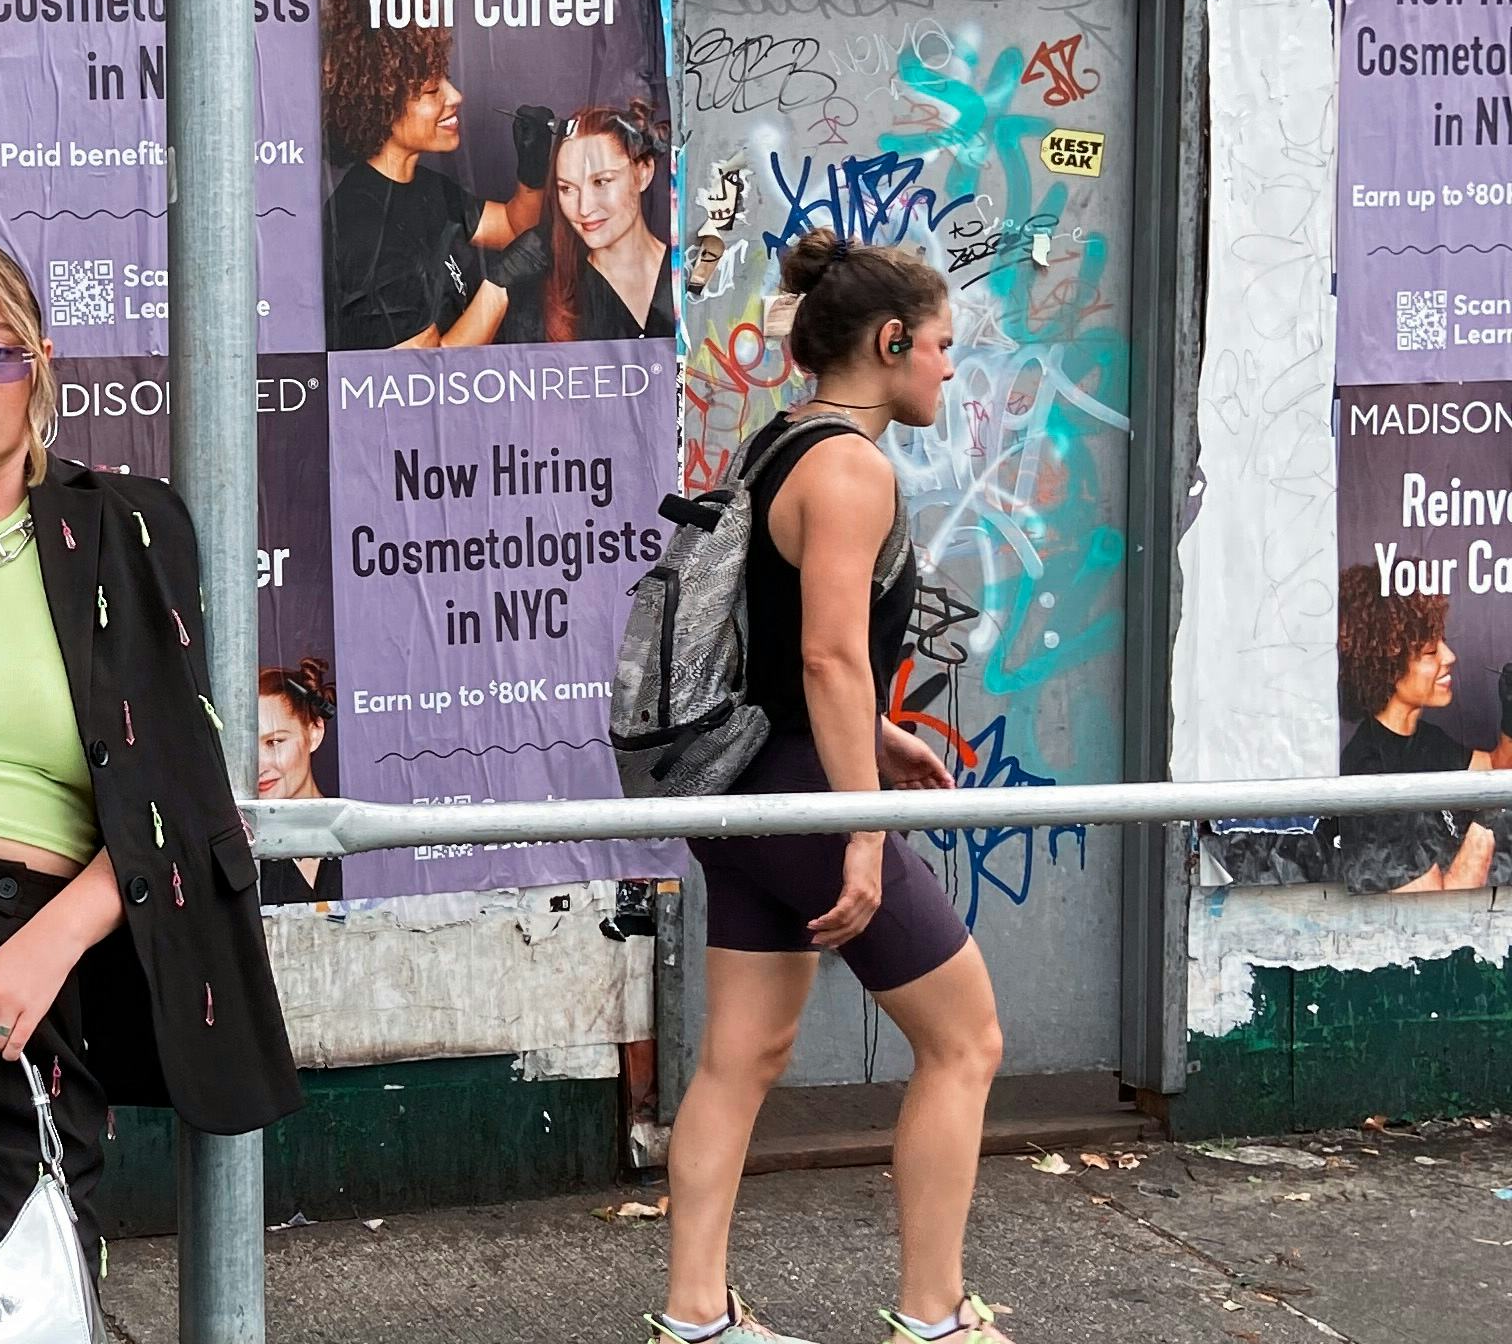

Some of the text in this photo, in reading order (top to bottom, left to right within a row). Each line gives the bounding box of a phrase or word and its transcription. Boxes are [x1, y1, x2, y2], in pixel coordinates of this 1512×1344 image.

[87, 50, 124, 100] in
[1434, 102, 1463, 146] in
[0, 142, 61, 167] Paid
[69, 141, 168, 167] benefit
[1049, 136, 1103, 156] KEST
[1050, 151, 1093, 170] GAK
[1352, 184, 1401, 207] Earn
[1407, 189, 1436, 212] up
[1441, 185, 1464, 206] to
[1453, 294, 1511, 316] Scan
[394, 444, 613, 508] Now Hiring
[351, 517, 662, 582] Cosmetologists
[1374, 542, 1458, 597] Your
[445, 587, 568, 646] in NYC
[353, 690, 412, 714] Earn
[419, 692, 452, 713] up
[458, 685, 485, 707] to
[489, 678, 547, 703] $80K
